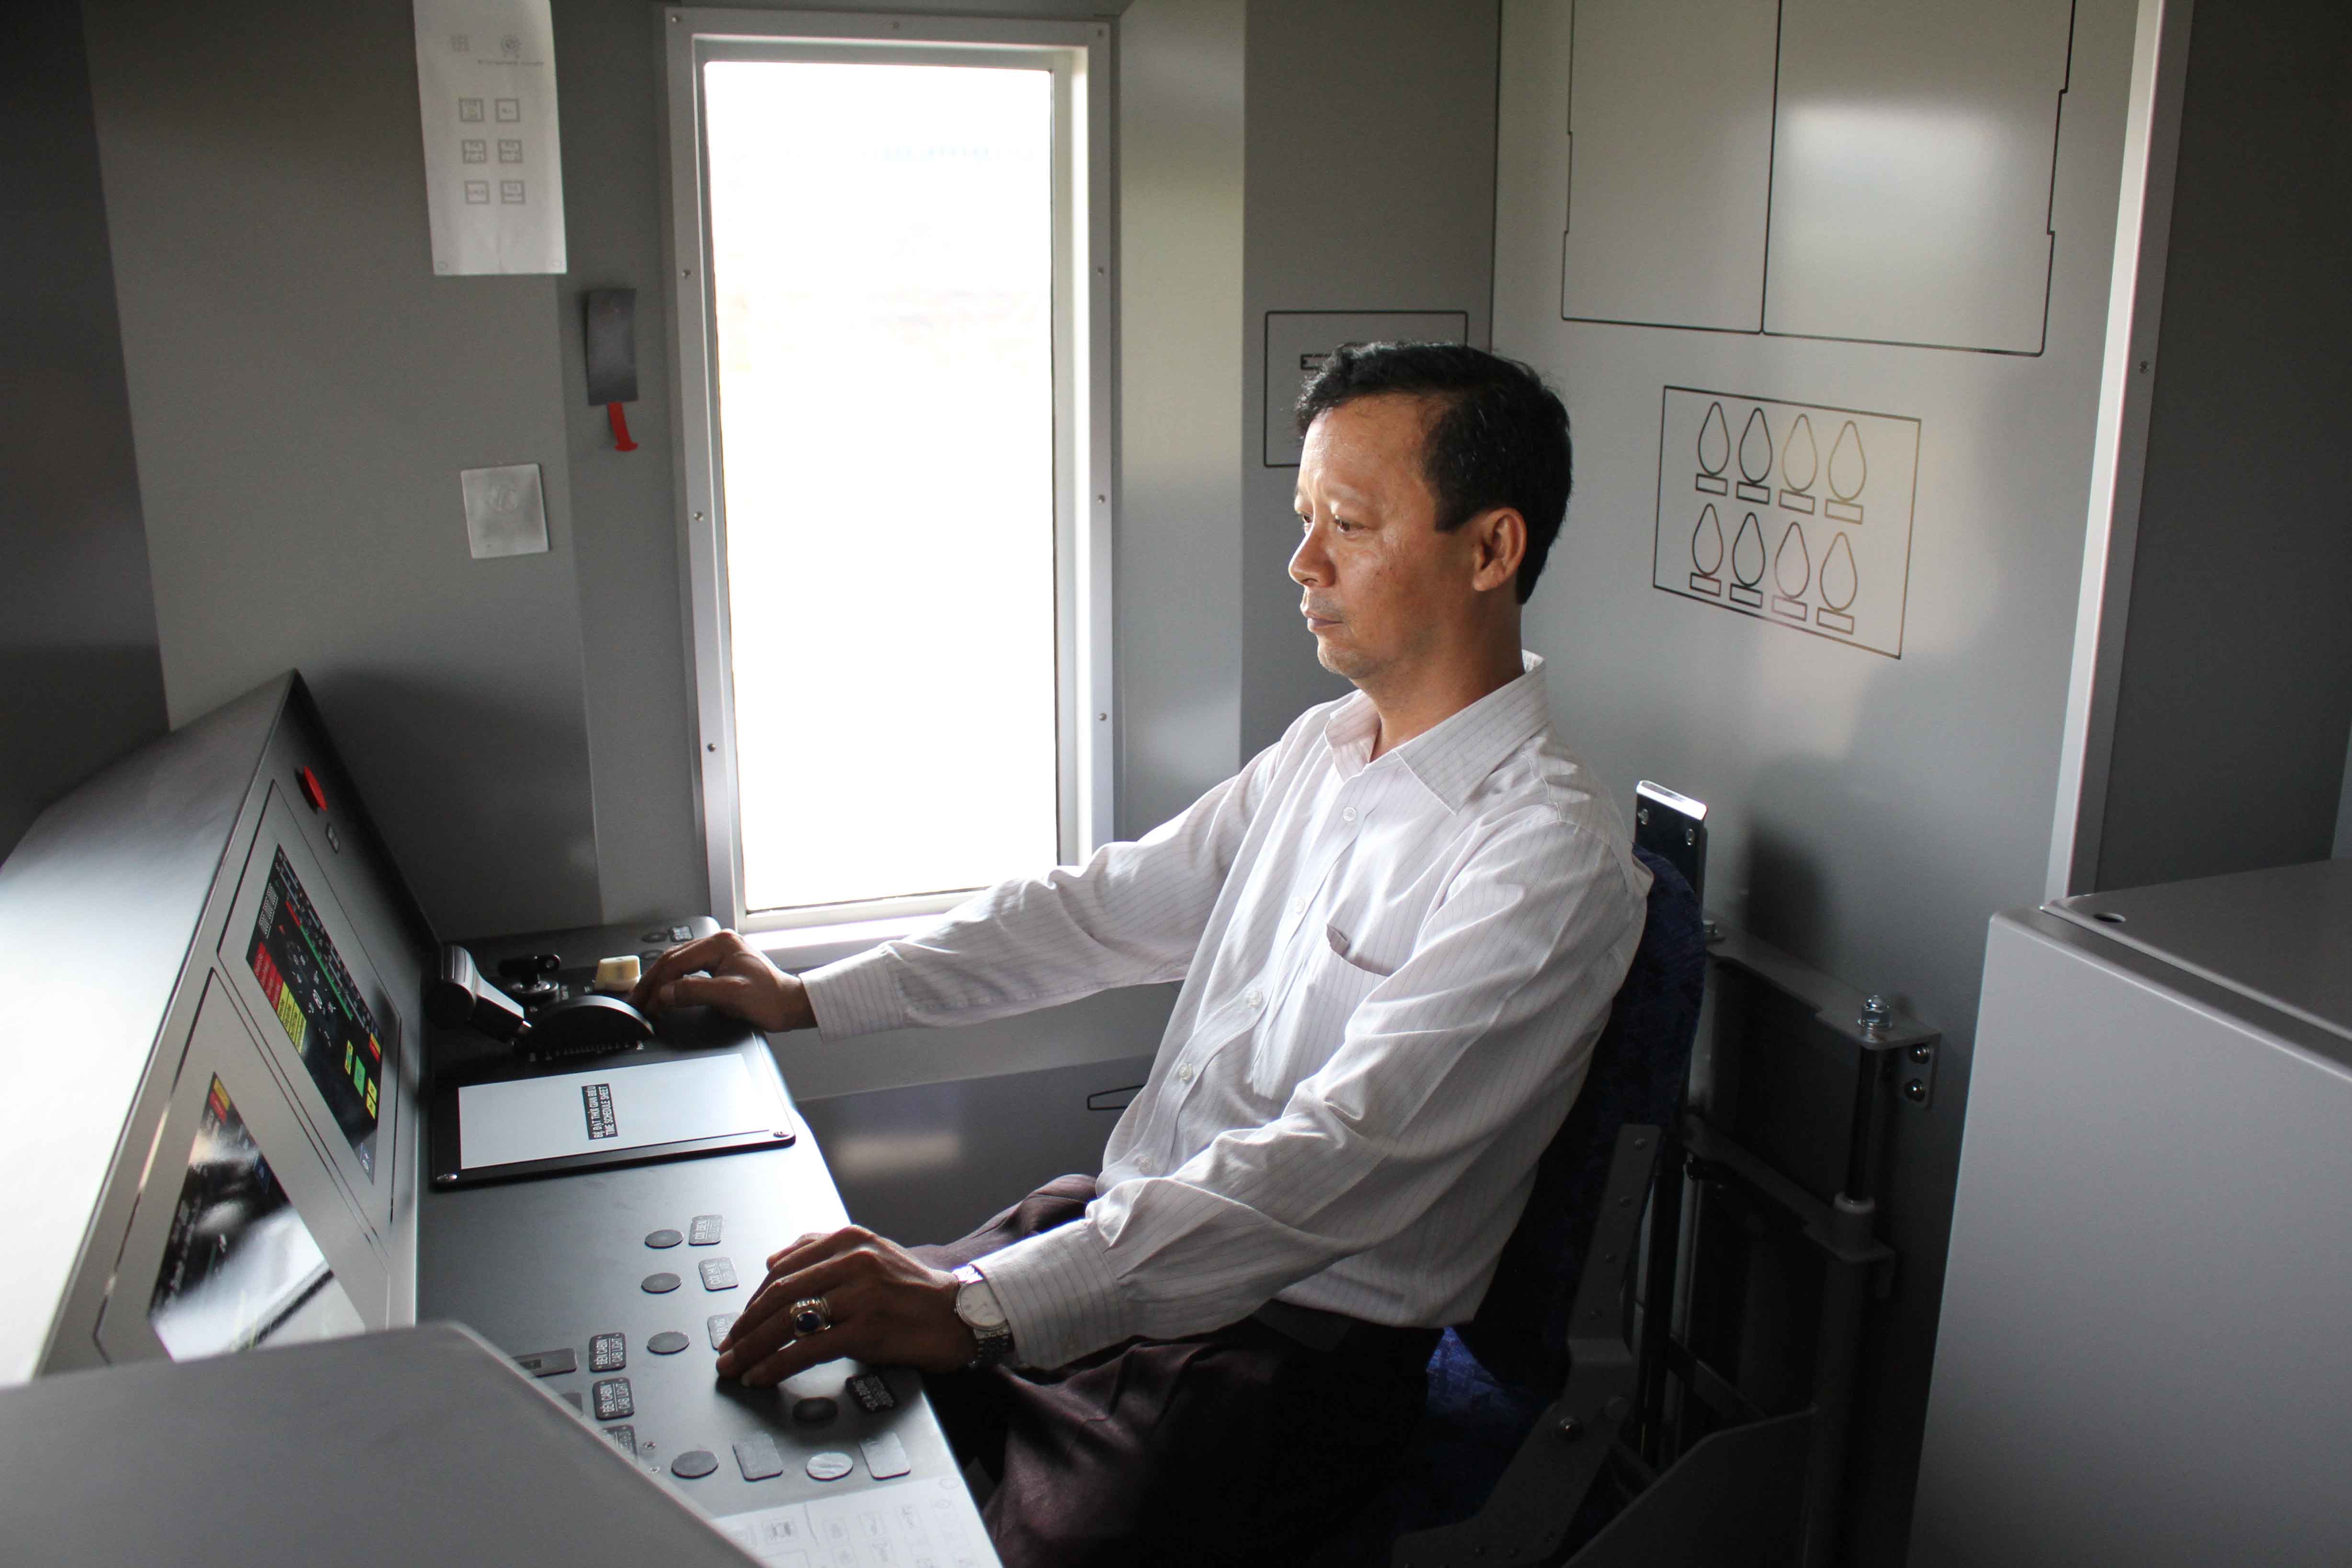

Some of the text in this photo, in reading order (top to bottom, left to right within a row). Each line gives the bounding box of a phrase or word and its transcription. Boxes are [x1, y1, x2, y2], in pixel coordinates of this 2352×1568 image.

[589, 1097, 598, 1108] GIAN
[599, 1086, 616, 1135] TIME SCHEDULE SHEET
[596, 1339, 608, 1354] CABIN
[612, 1339, 623, 1362] CAB LIGHT
[600, 1385, 613, 1401] CABIN
[616, 1384, 630, 1409] CAB LIGHT
